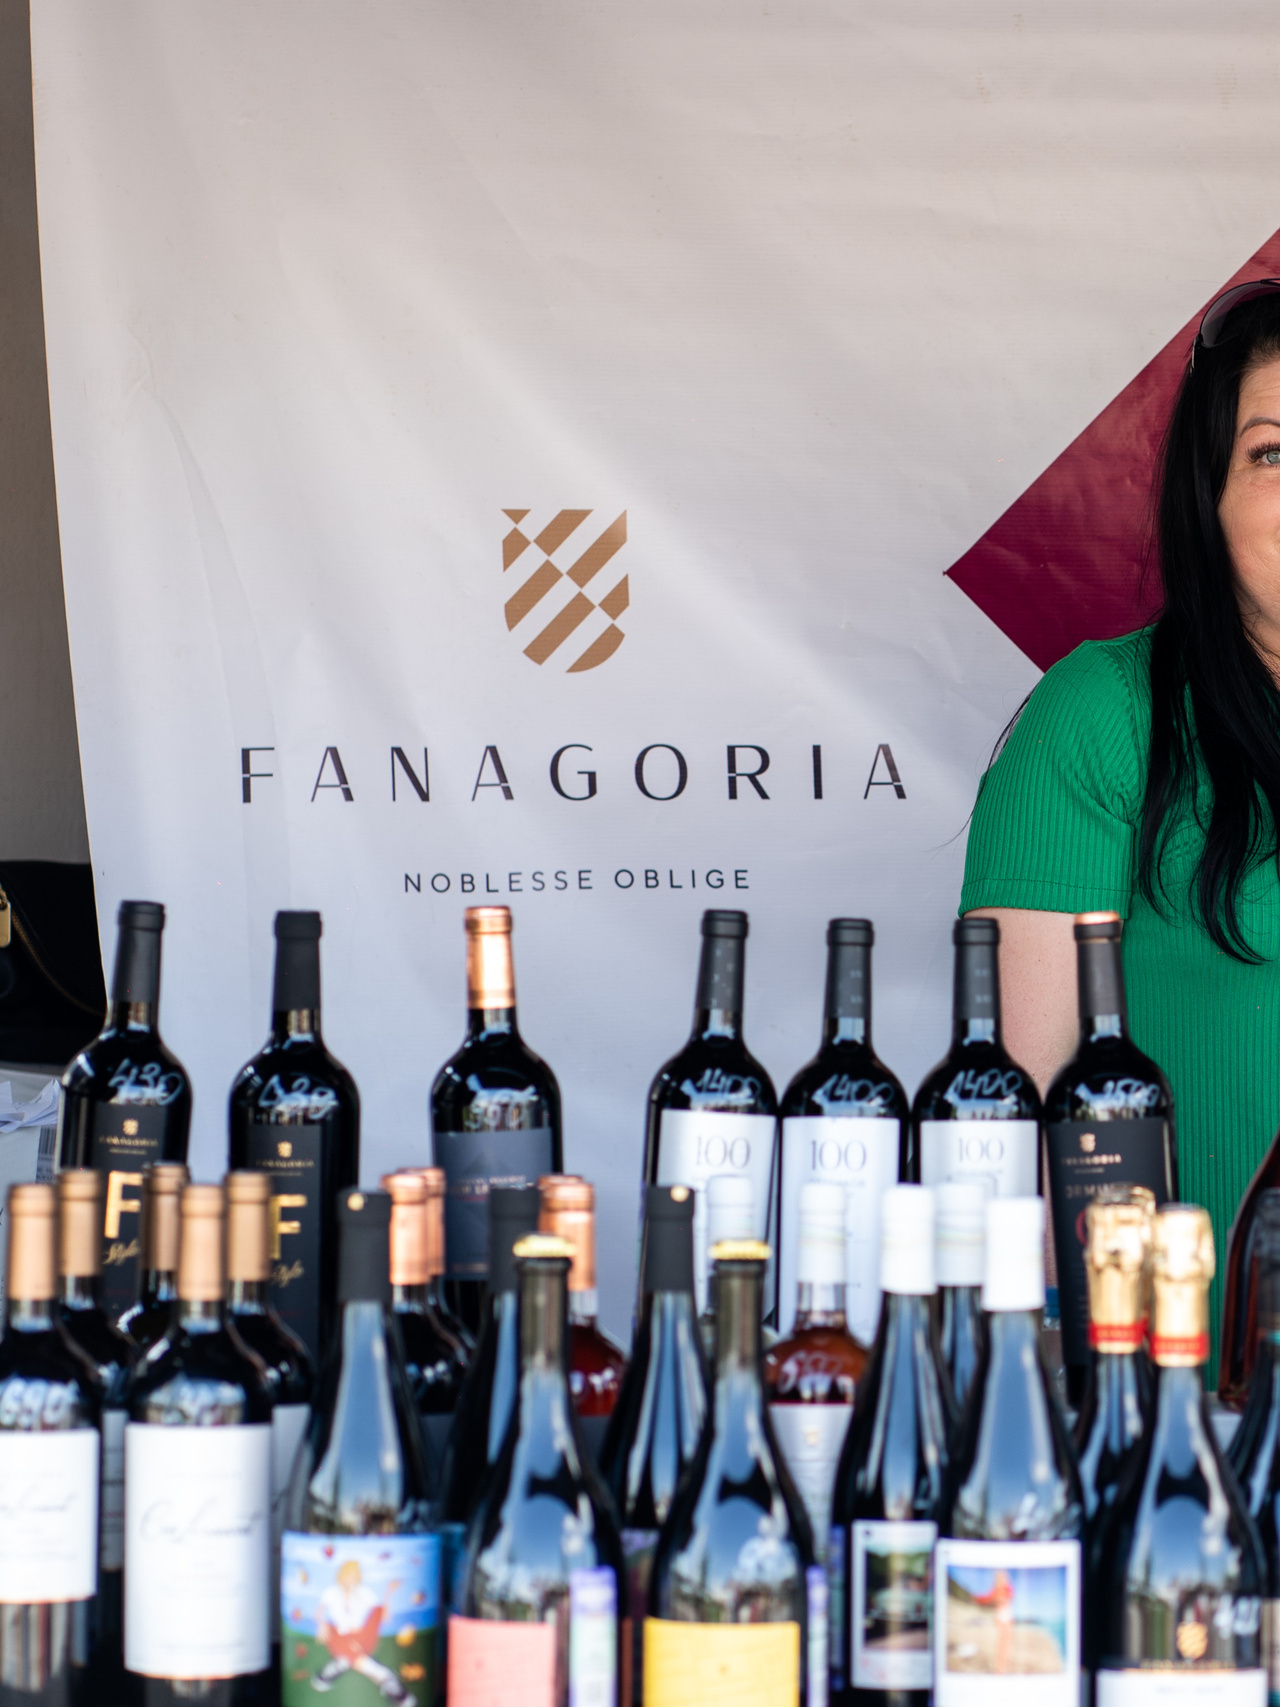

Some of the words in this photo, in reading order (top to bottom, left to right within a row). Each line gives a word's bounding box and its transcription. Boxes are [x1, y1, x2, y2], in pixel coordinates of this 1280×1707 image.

[241, 744, 907, 803] FANAGORIA
[404, 869, 594, 893] NOBLESSE
[614, 868, 751, 890] OBLIGE
[696, 1135, 752, 1169] 100
[807, 1139, 867, 1172] 100
[958, 1137, 1005, 1163] 100
